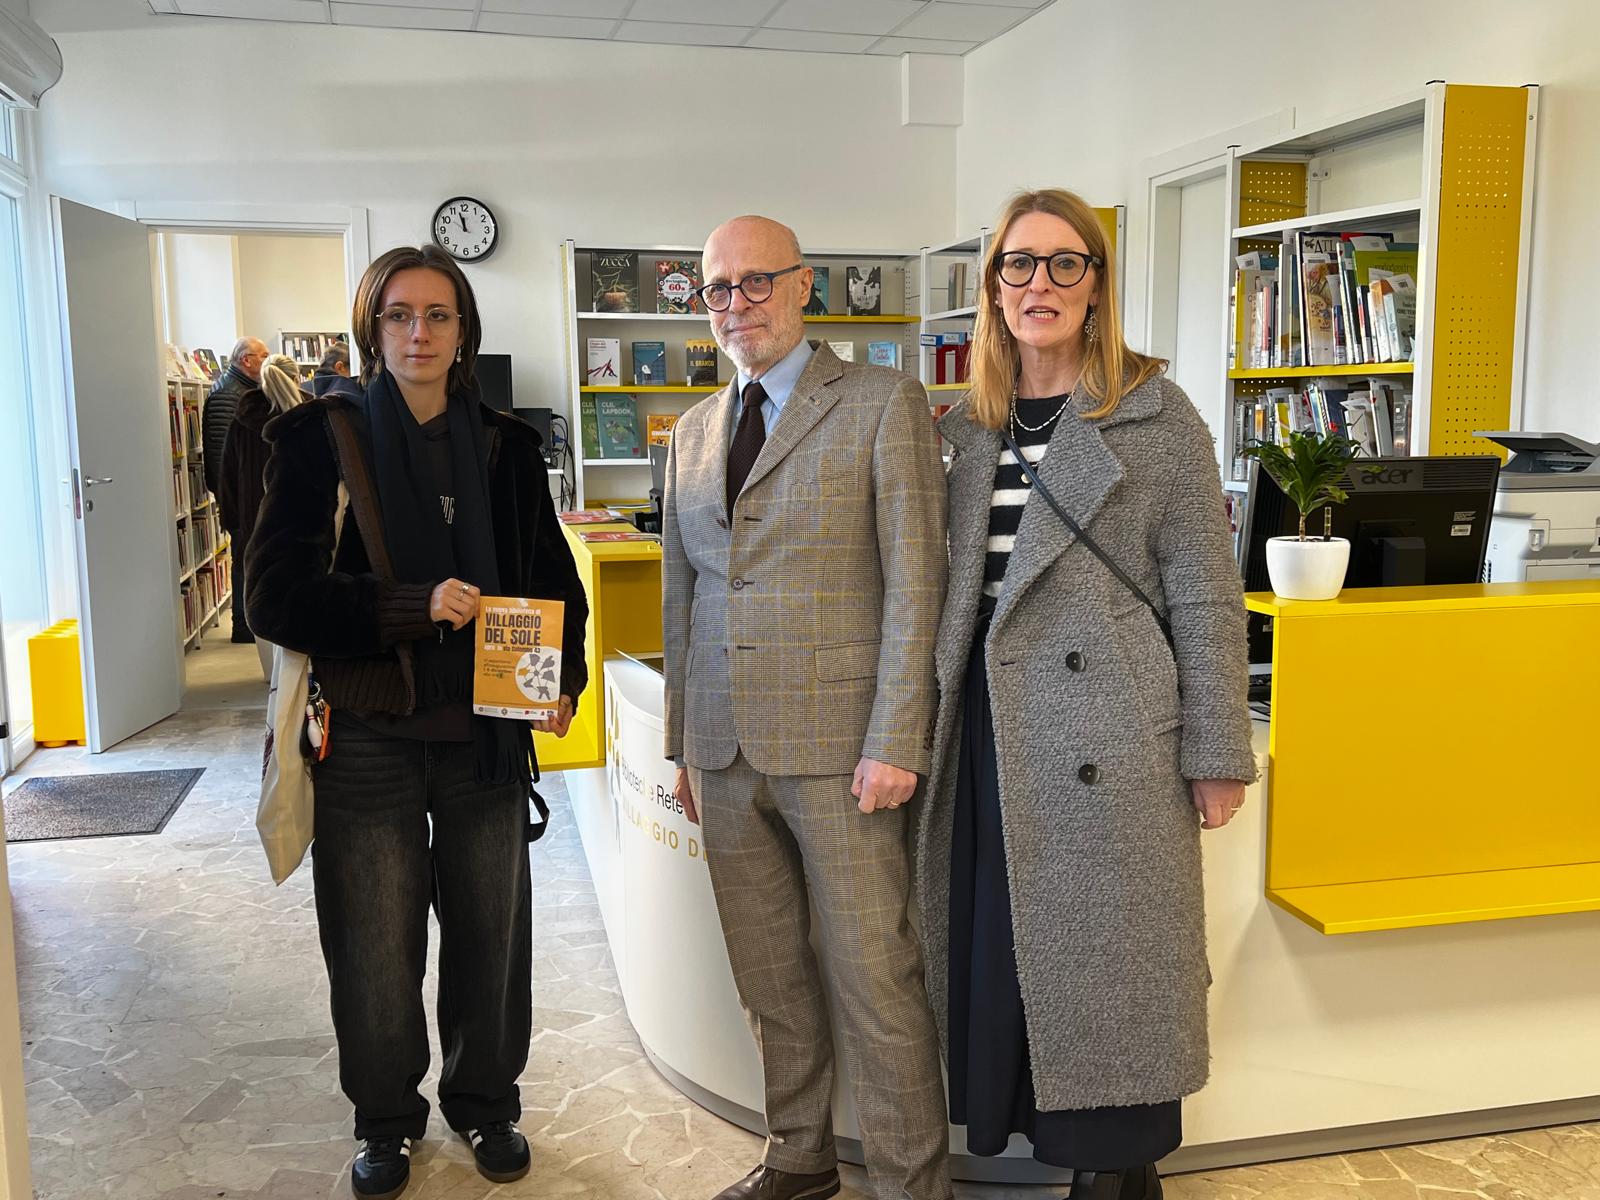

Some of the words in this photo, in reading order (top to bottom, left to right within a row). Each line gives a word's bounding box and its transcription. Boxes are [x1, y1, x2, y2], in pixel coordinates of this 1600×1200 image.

[450, 207, 456, 215] 11
[460, 204, 469, 212] 12
[473, 207, 477, 215] 1
[442, 216, 451, 224] 10
[480, 214, 486, 223] 2
[440, 226, 446, 234] 9
[484, 226, 490, 234] 3
[443, 236, 450, 245] 8
[481, 237, 488, 245] 4
[452, 244, 458, 252] 7
[474, 245, 480, 253] 5
[1314, 239, 1337, 254] ATL
[463, 248, 469, 256] 6
[1361, 469, 1414, 485] acer
[485, 613, 542, 629] VILLAGGIO
[484, 627, 507, 644] DEL
[510, 629, 541, 646] SOLE
[656, 784, 684, 815] Rete
